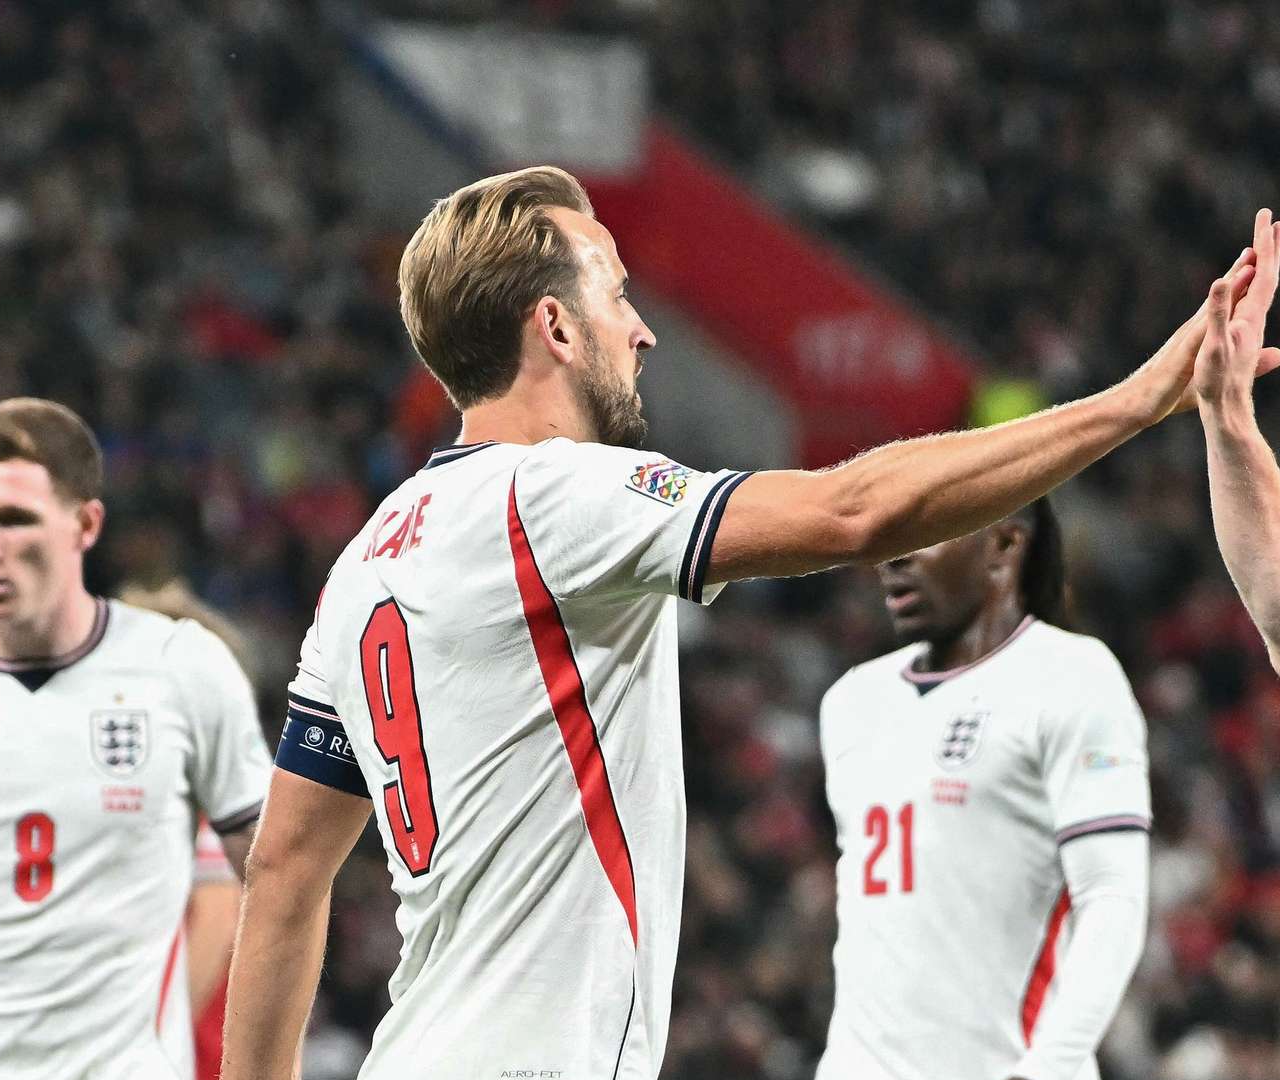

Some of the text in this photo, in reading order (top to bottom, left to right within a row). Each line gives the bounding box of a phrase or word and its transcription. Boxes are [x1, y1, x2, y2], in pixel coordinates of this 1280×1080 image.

[359, 595, 439, 878] 9
[14, 812, 57, 903] 8
[863, 802, 915, 897] 21
